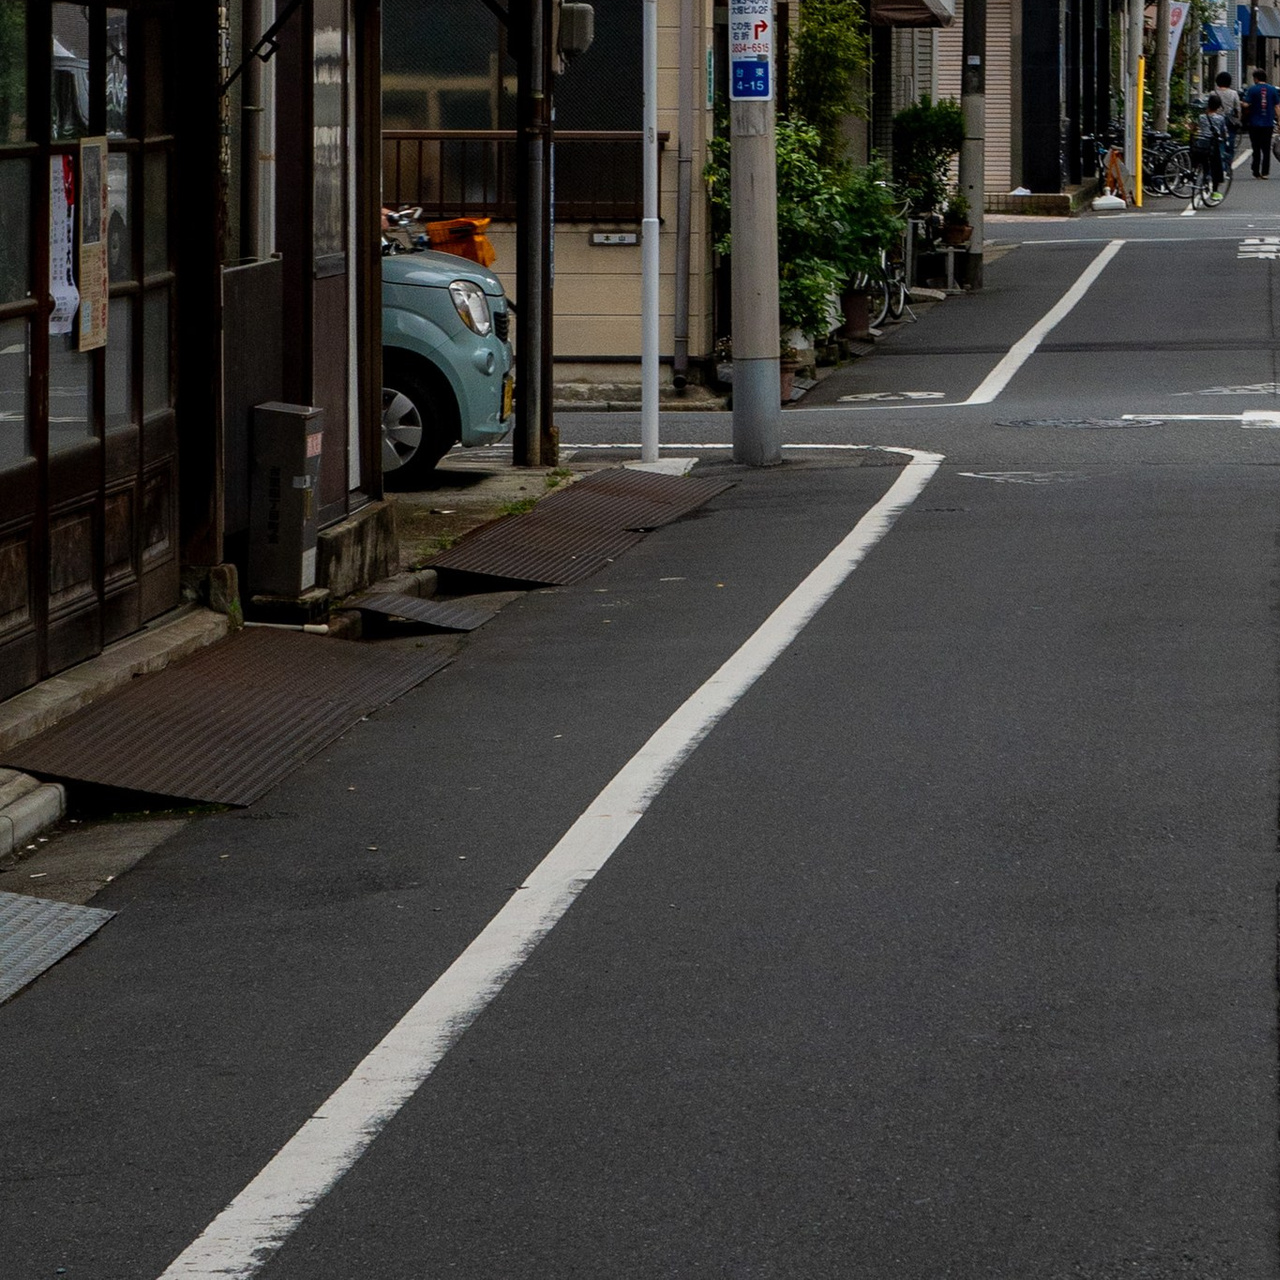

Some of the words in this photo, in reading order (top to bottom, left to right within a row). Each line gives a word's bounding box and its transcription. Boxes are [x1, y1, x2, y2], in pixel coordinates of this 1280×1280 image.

[731, 22, 752, 31] この先
[733, 31, 750, 40] 右折
[735, 68, 765, 78] 台東
[736, 81, 765, 91] 4-15
